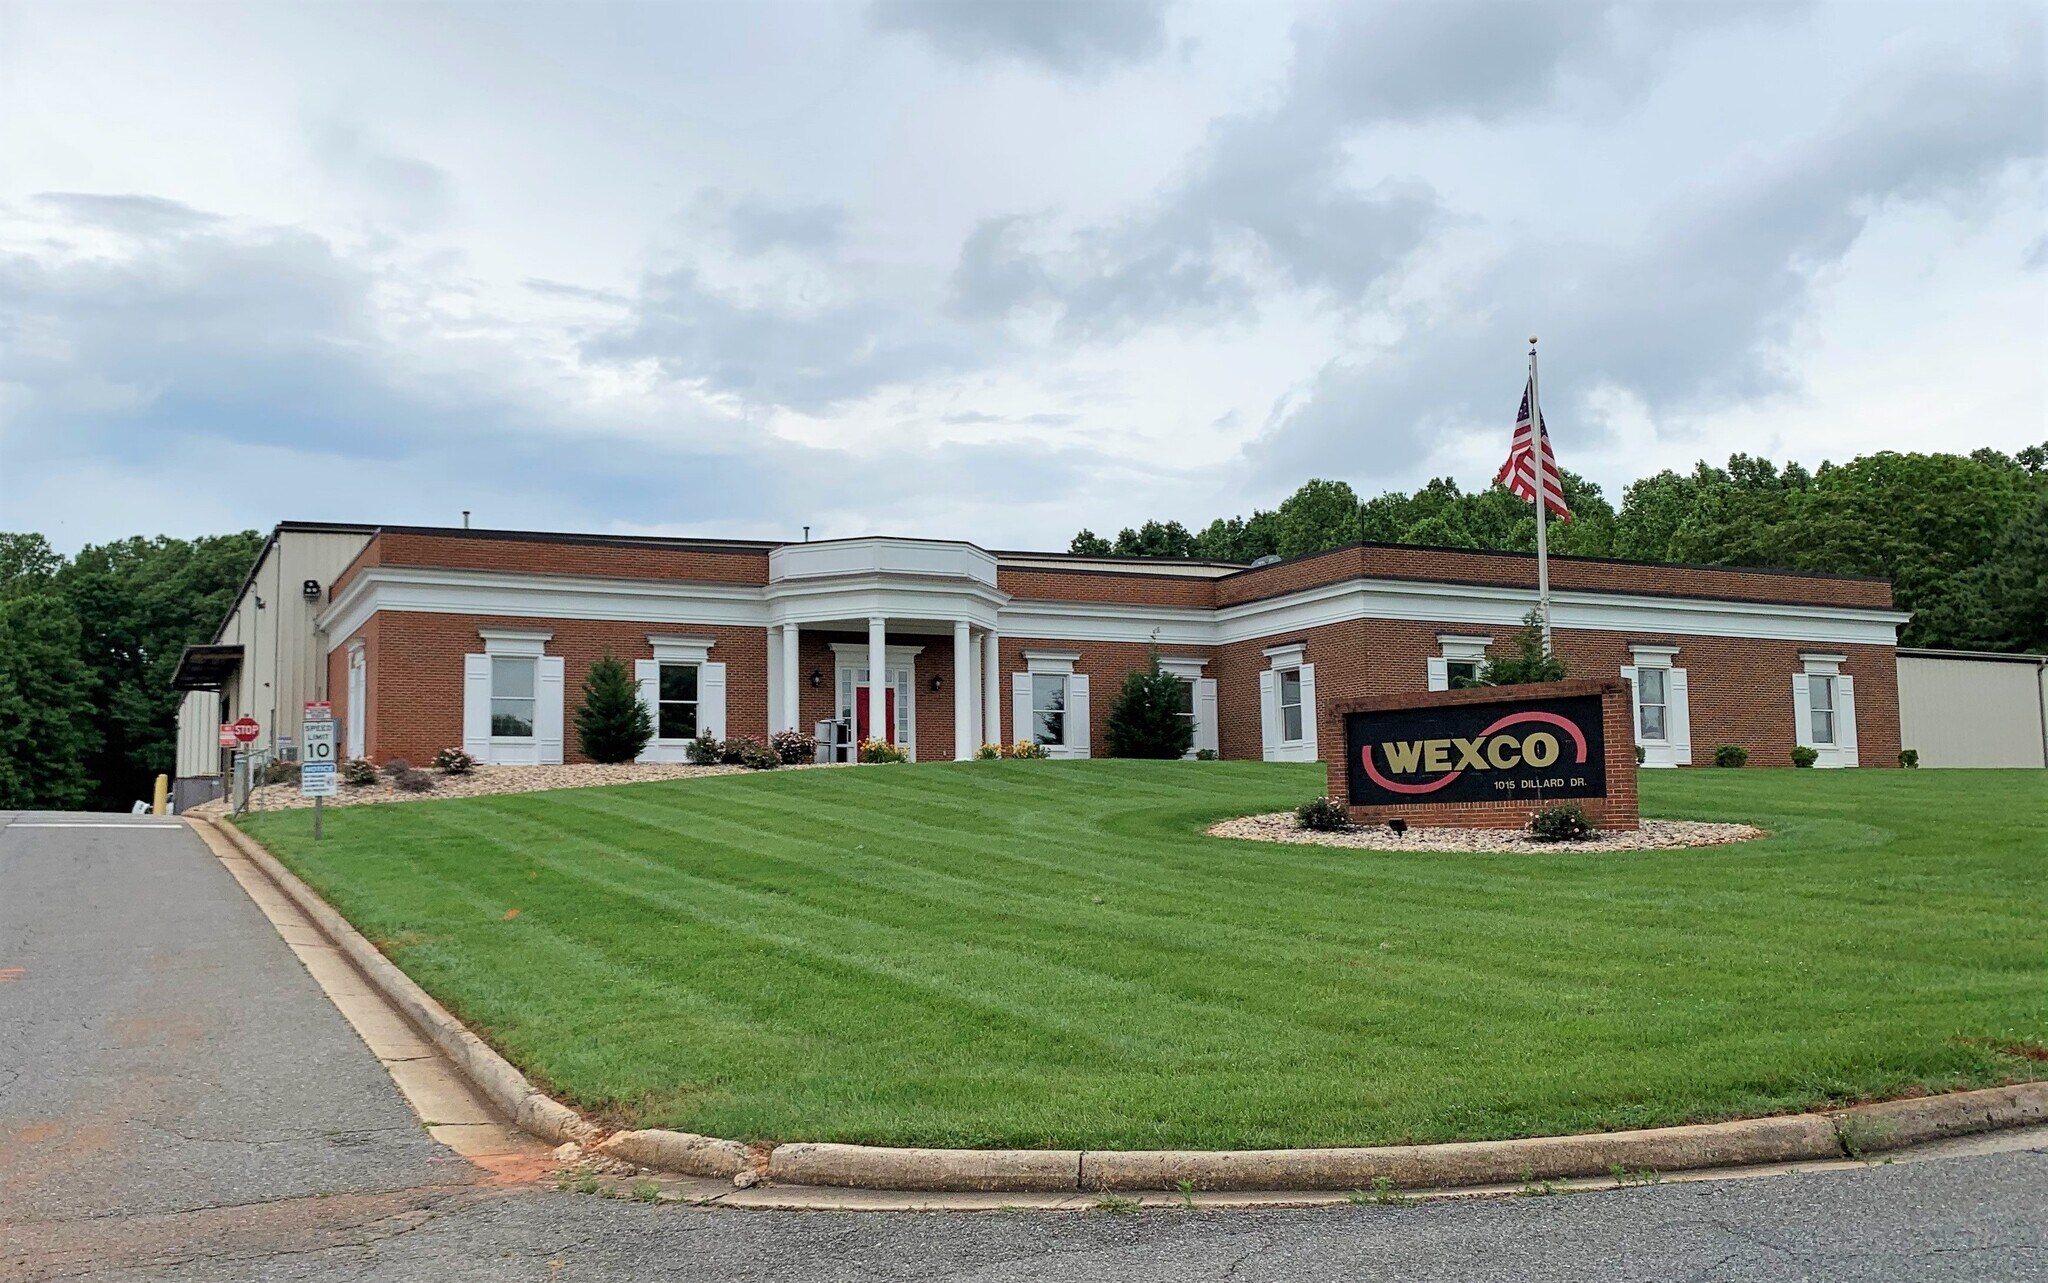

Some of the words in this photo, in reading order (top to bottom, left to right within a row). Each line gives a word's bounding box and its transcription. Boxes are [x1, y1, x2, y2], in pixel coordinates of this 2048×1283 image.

[235, 725, 259, 735] STOP
[308, 743, 329, 758] 10
[1382, 732, 1559, 773] WEXCO
[1494, 780, 1516, 789] 1015
[1521, 779, 1564, 788] DILLARD
[1570, 777, 1587, 786] DR.
